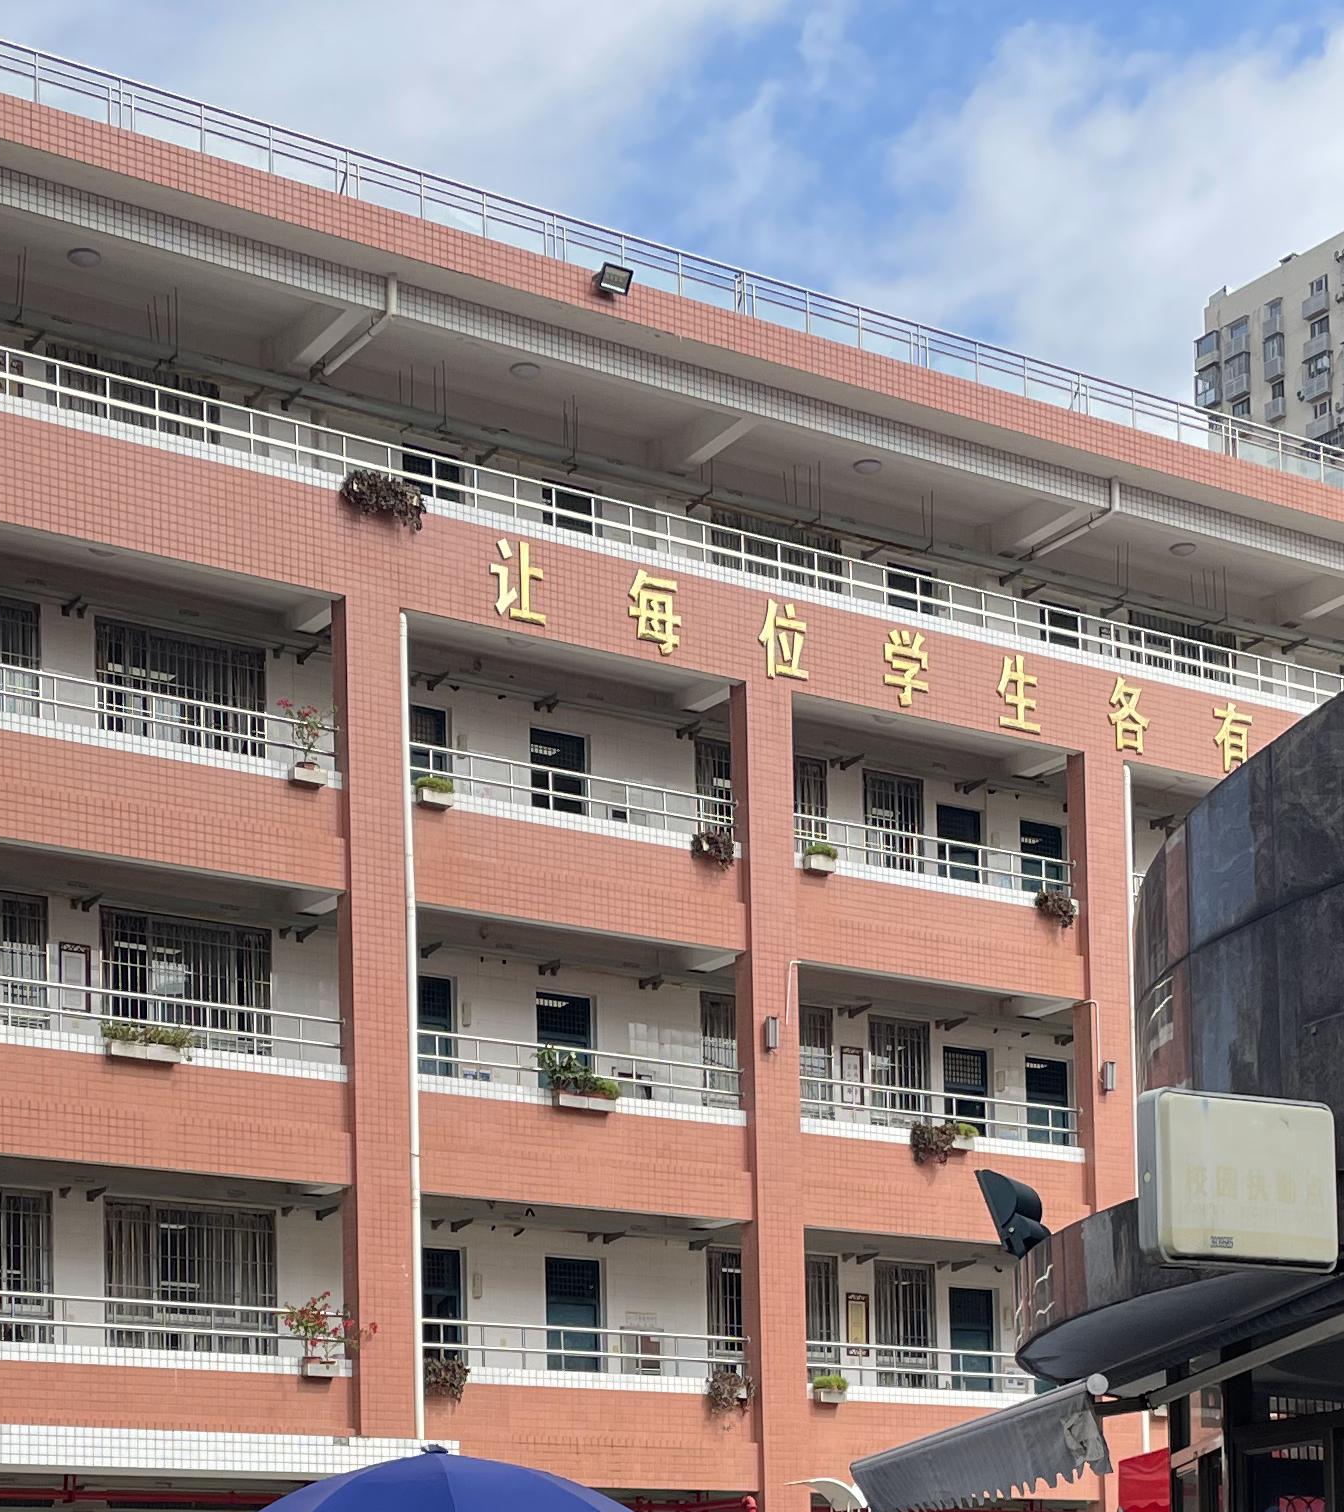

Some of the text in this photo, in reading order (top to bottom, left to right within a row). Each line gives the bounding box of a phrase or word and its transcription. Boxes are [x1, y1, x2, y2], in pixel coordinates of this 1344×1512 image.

[488, 537, 1254, 774] 让每位学生各有
